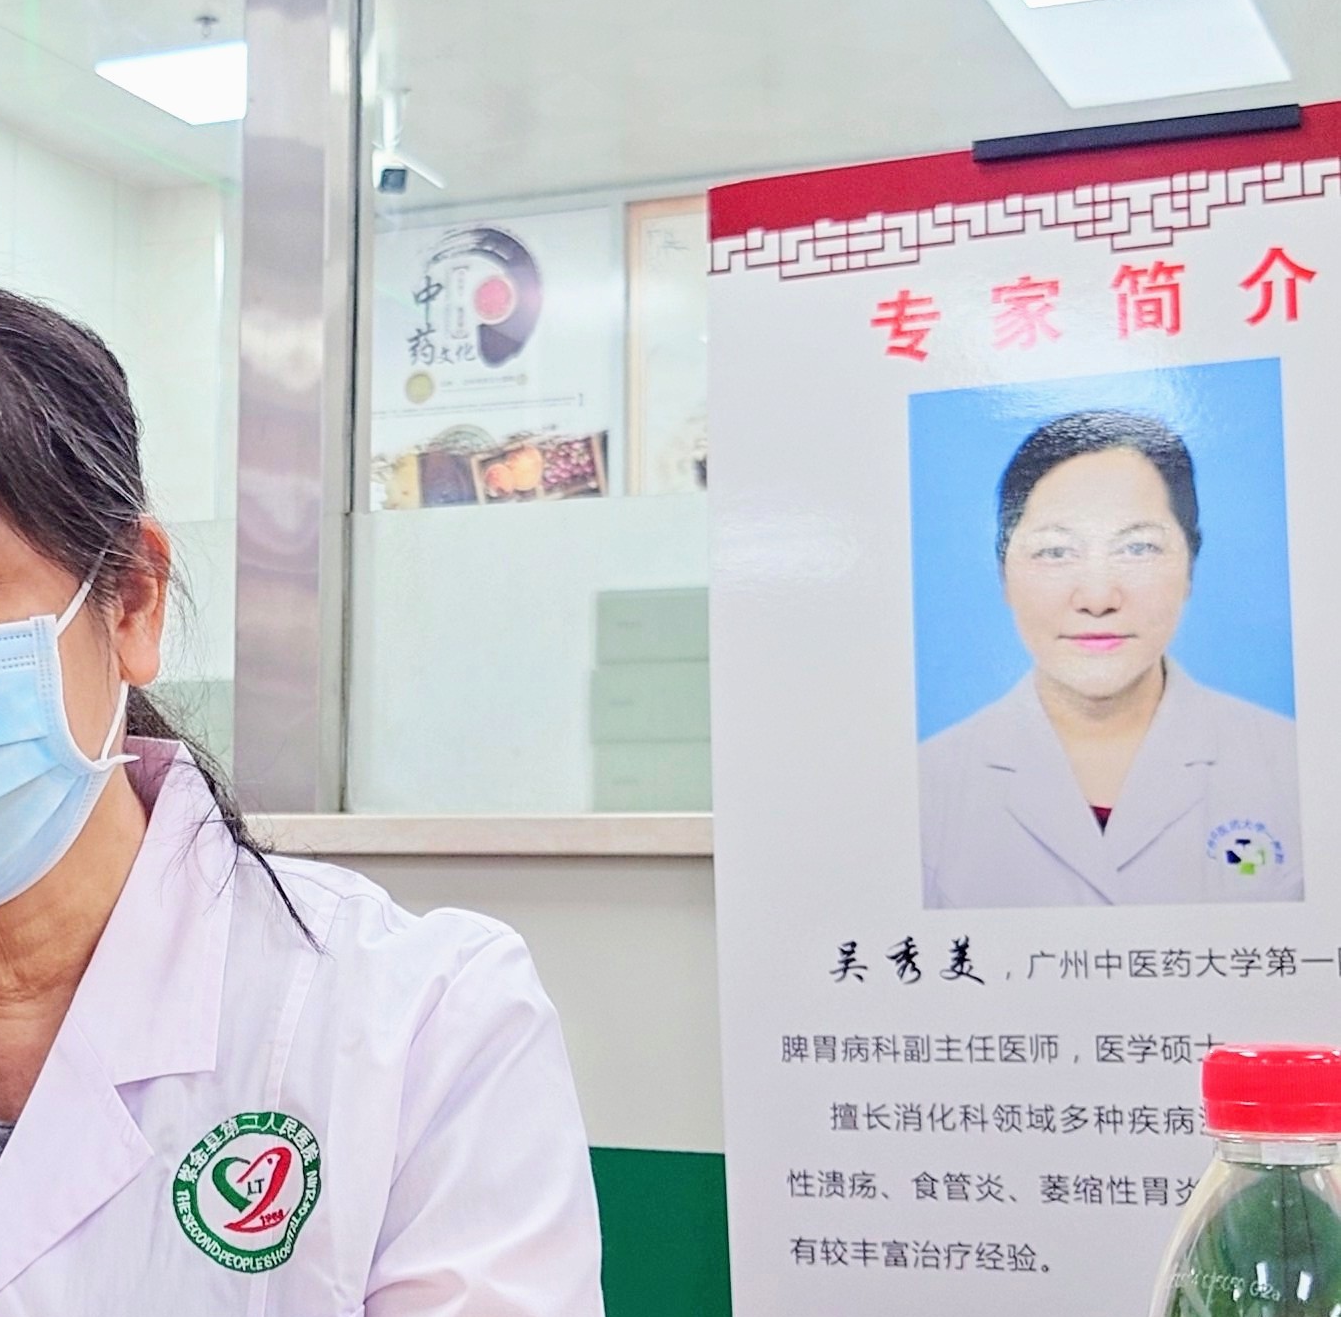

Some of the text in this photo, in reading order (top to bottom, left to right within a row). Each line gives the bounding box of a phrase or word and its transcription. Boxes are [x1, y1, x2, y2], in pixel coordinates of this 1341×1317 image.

[870, 246, 1318, 364] 专家简介
[829, 1102, 1207, 1136] 擅长消化科领域多种疾病
[789, 1236, 1051, 1275] 有较丰富治疗经验。
